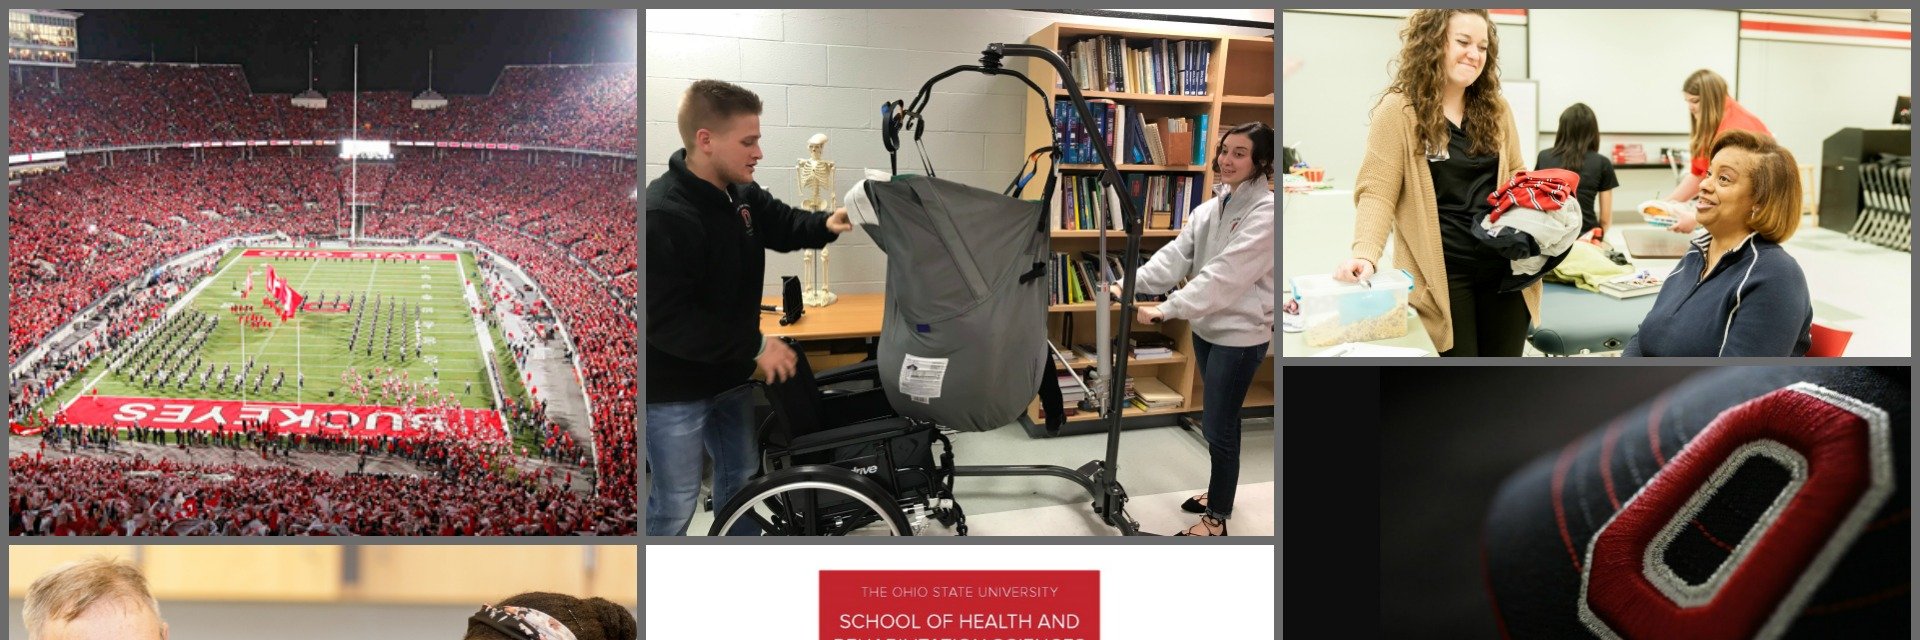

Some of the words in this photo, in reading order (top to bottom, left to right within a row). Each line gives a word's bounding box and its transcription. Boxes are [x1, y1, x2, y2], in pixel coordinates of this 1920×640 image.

[113, 403, 446, 432] BUCKEYES
[861, 587, 886, 597] THE
[892, 587, 927, 597] OHIO
[933, 587, 972, 597] STATE
[979, 587, 1057, 597] UNIVERSITY
[840, 614, 921, 629] SCHOOL
[927, 614, 953, 628] OF
[960, 614, 1031, 628] HEALTH
[1038, 614, 1079, 629] AND
